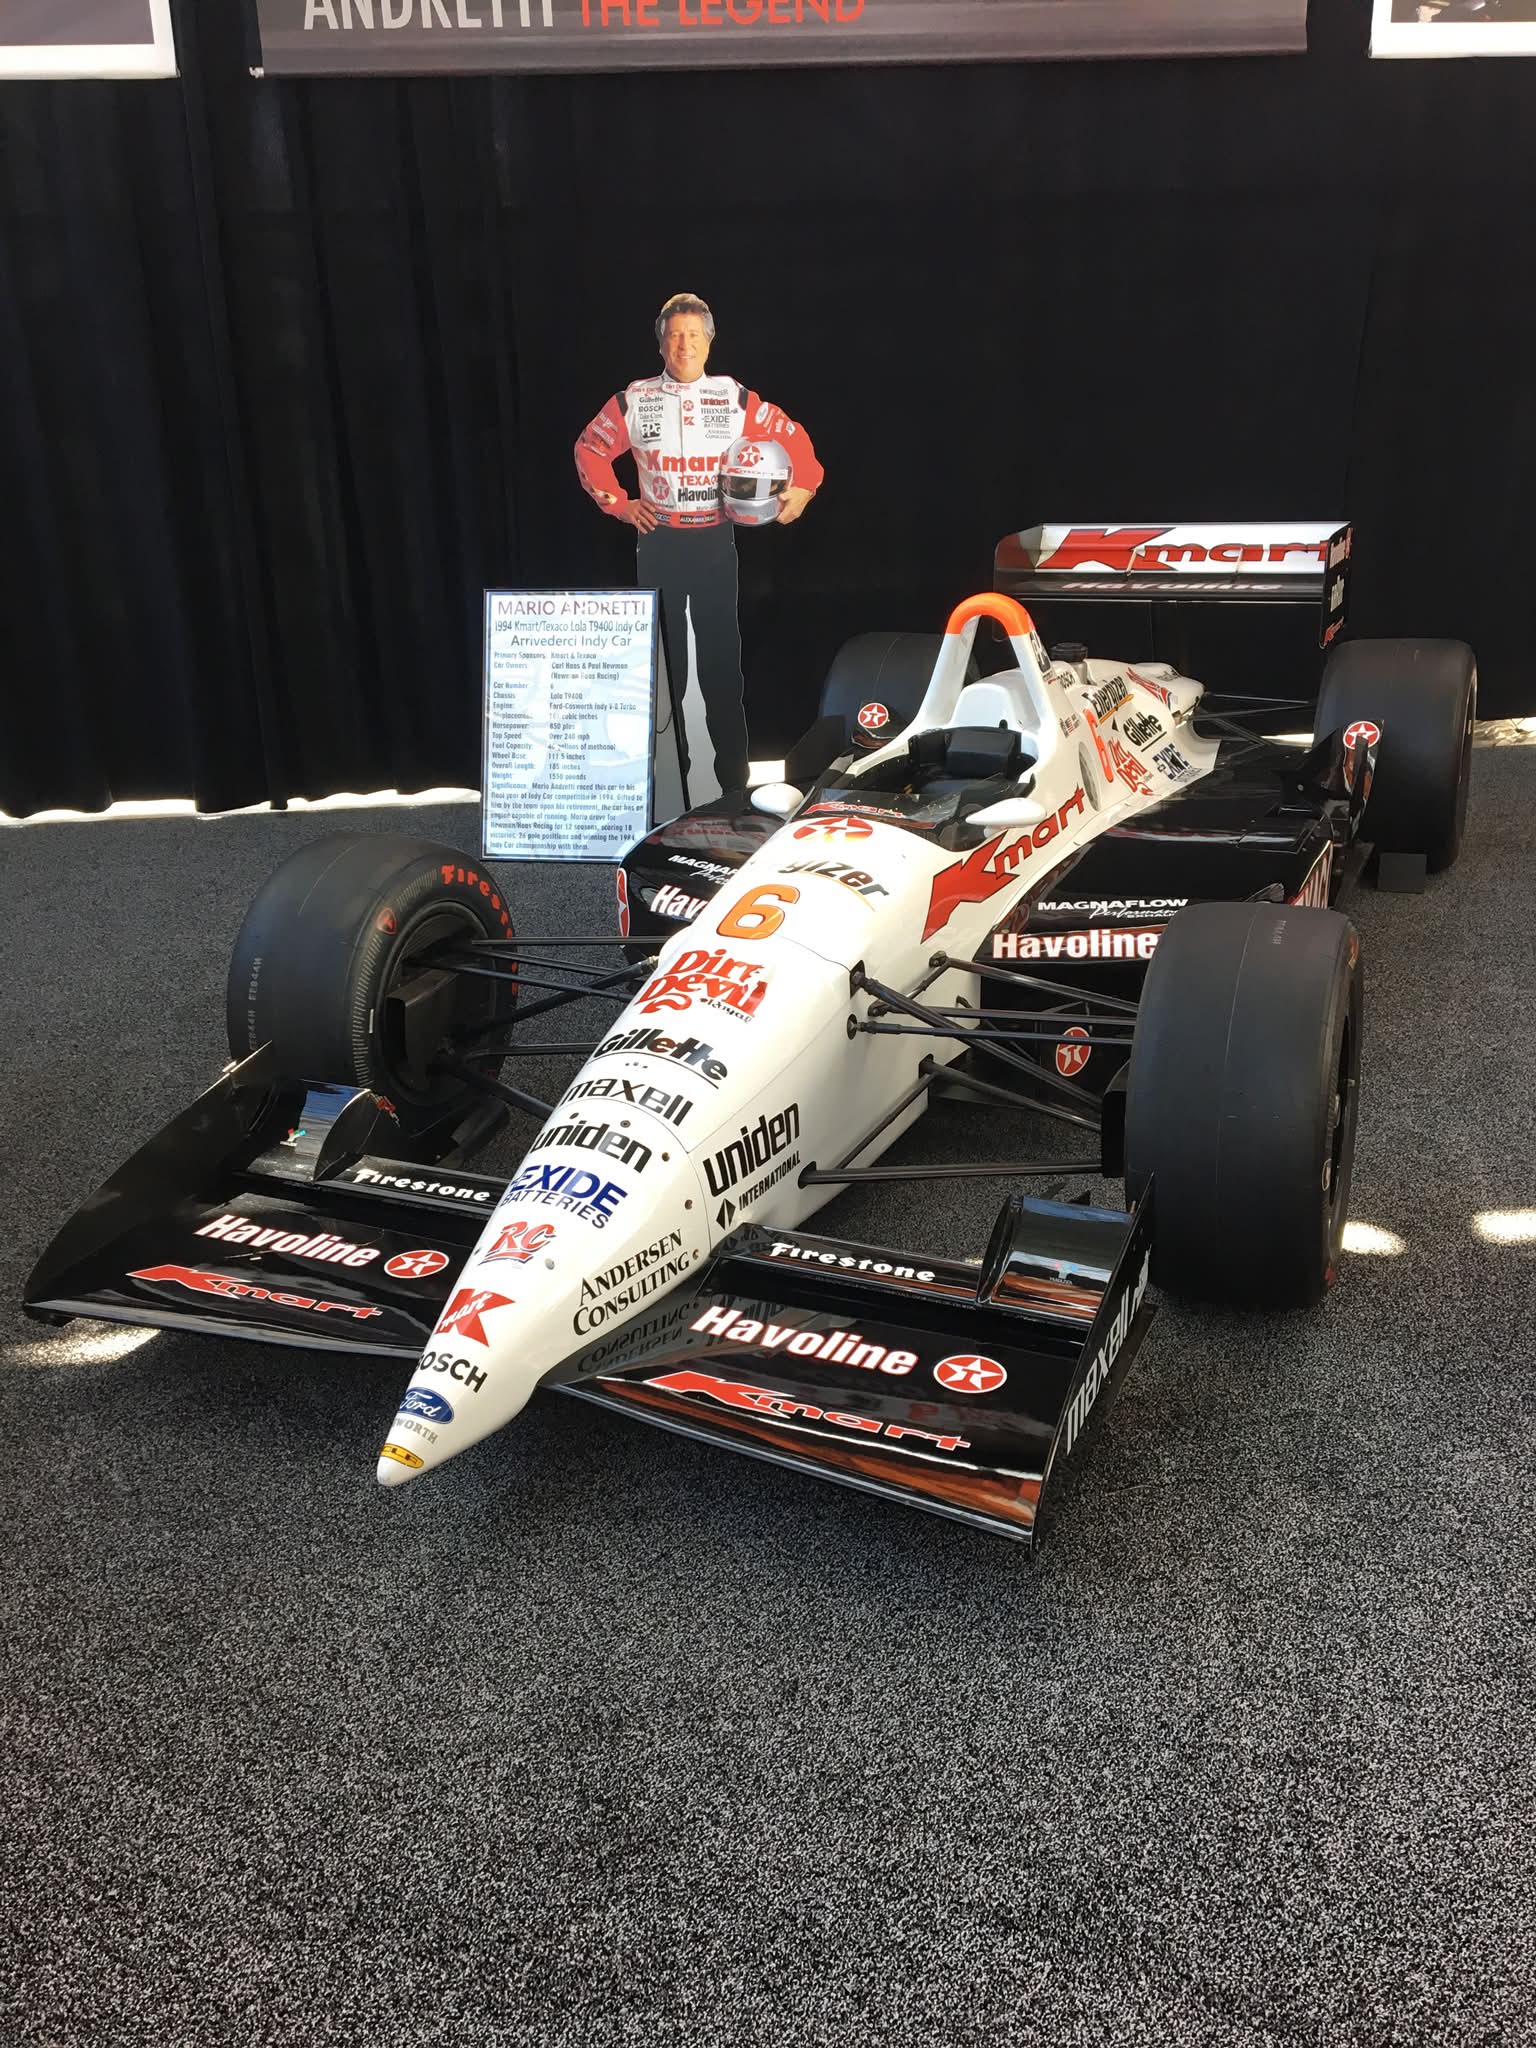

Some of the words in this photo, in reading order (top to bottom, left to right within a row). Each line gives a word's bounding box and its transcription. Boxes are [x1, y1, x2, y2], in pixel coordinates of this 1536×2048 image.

[701, 415, 730, 423] EXIDE
[678, 487, 718, 502] Havolin
[1036, 527, 1327, 571] Kmart
[495, 620, 512, 632] 1994
[514, 620, 569, 632] Kmart/Texaco
[570, 620, 586, 632] Lola
[589, 620, 614, 632] T9400
[615, 621, 633, 634] Indy
[635, 621, 648, 632] Car
[498, 600, 555, 615] MARIO
[561, 600, 646, 615] ANDRETTI
[511, 635, 577, 646] Arrivederci
[581, 635, 607, 649] Indy
[612, 636, 632, 646] Car
[1123, 712, 1162, 747] Gillette
[920, 786, 1086, 944] Kmart
[716, 883, 801, 940] 6
[1038, 899, 1188, 910] MAGNAFLOW
[664, 949, 765, 979] Dirt
[993, 929, 1160, 958] Havoline
[634, 973, 769, 1018] Devil
[593, 1028, 728, 1081] Gillette
[562, 1078, 694, 1126] maxell
[531, 1120, 652, 1173] uniden
[703, 1102, 800, 1198] uniden
[353, 1169, 491, 1202] Firestone
[511, 1165, 628, 1217] EXIDE
[739, 1151, 801, 1210] INTERNATIONAL
[500, 1190, 609, 1229] BATTERIES
[194, 1213, 381, 1268] Havoline
[481, 1220, 556, 1257] RC
[579, 1229, 683, 1306] ANDERSEN
[769, 1242, 936, 1283] Firestone
[126, 1264, 383, 1319] Kmart
[572, 1250, 690, 1336] CONSULTING
[689, 1305, 919, 1376] Havoline
[1067, 1285, 1130, 1456] maxell
[400, 1391, 441, 1417] Ford
[644, 1370, 972, 1452] Kmart
